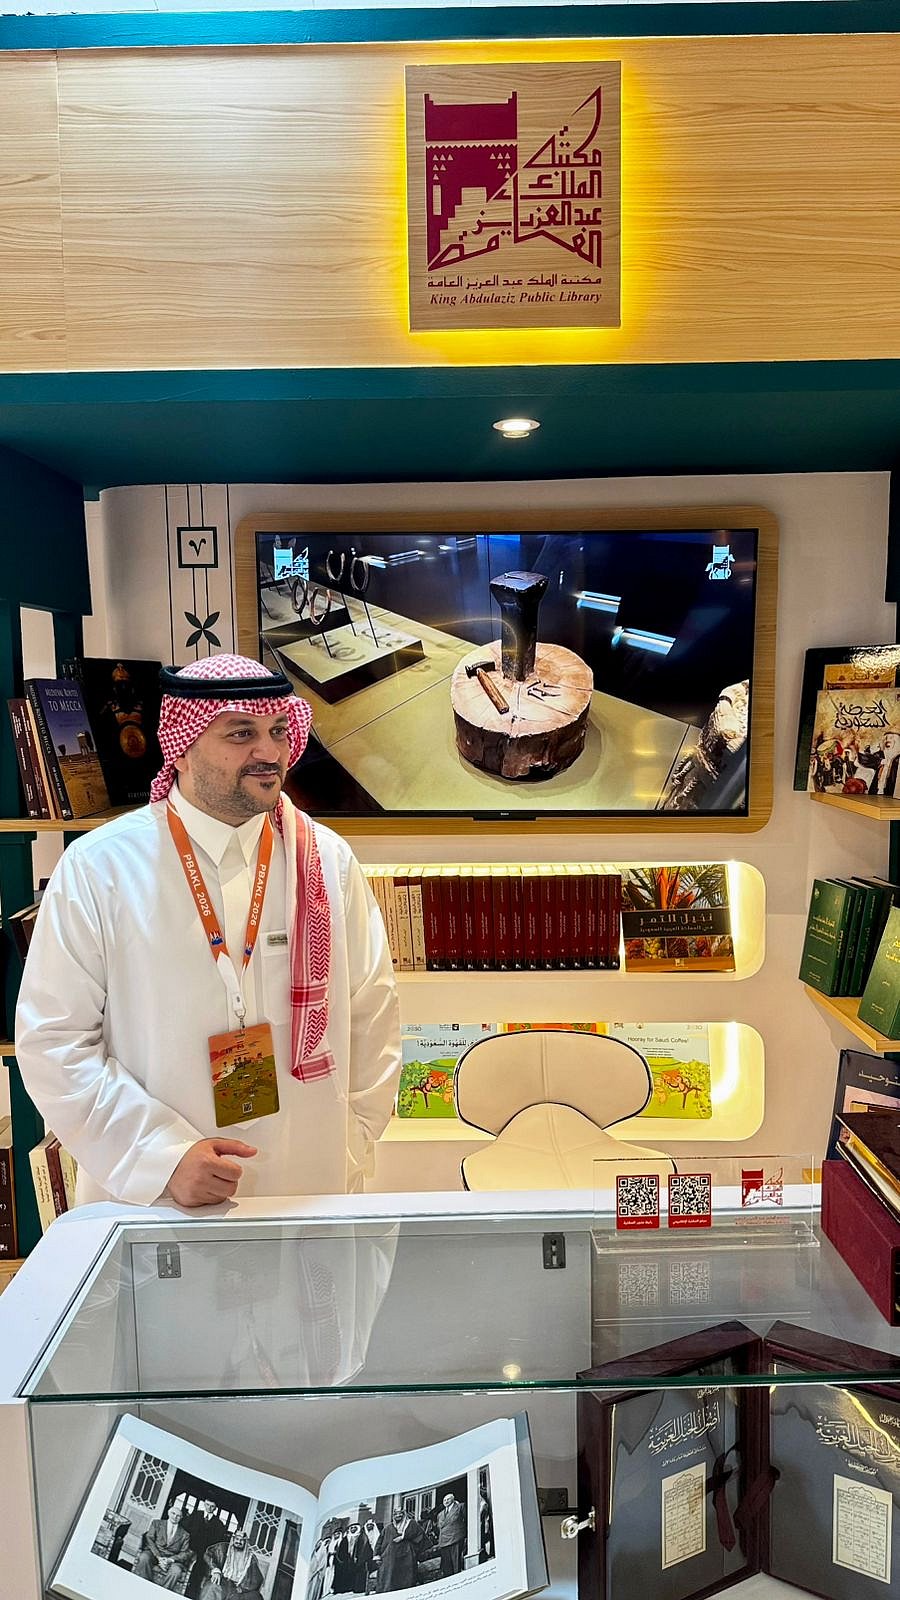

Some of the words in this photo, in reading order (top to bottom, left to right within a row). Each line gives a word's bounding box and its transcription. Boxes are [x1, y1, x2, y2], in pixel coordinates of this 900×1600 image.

[427, 275, 463, 288] العامة
[466, 274, 499, 290] العزيز
[502, 277, 523, 289] عبد
[527, 273, 558, 287] الملك
[560, 274, 602, 285] مكتبة
[430, 293, 457, 306] King
[460, 293, 516, 304] Abdulaziz
[519, 291, 556, 303] Public
[559, 291, 602, 304] Library
[48, 700, 59, 712] TO
[60, 700, 83, 712] MECCA
[839, 699, 887, 718] العرضة
[834, 713, 890, 732] السعودية
[183, 853, 201, 891] PBAKL
[196, 891, 211, 917] 2026
[254, 863, 267, 899] PBAKL
[250, 901, 260, 927] 2026
